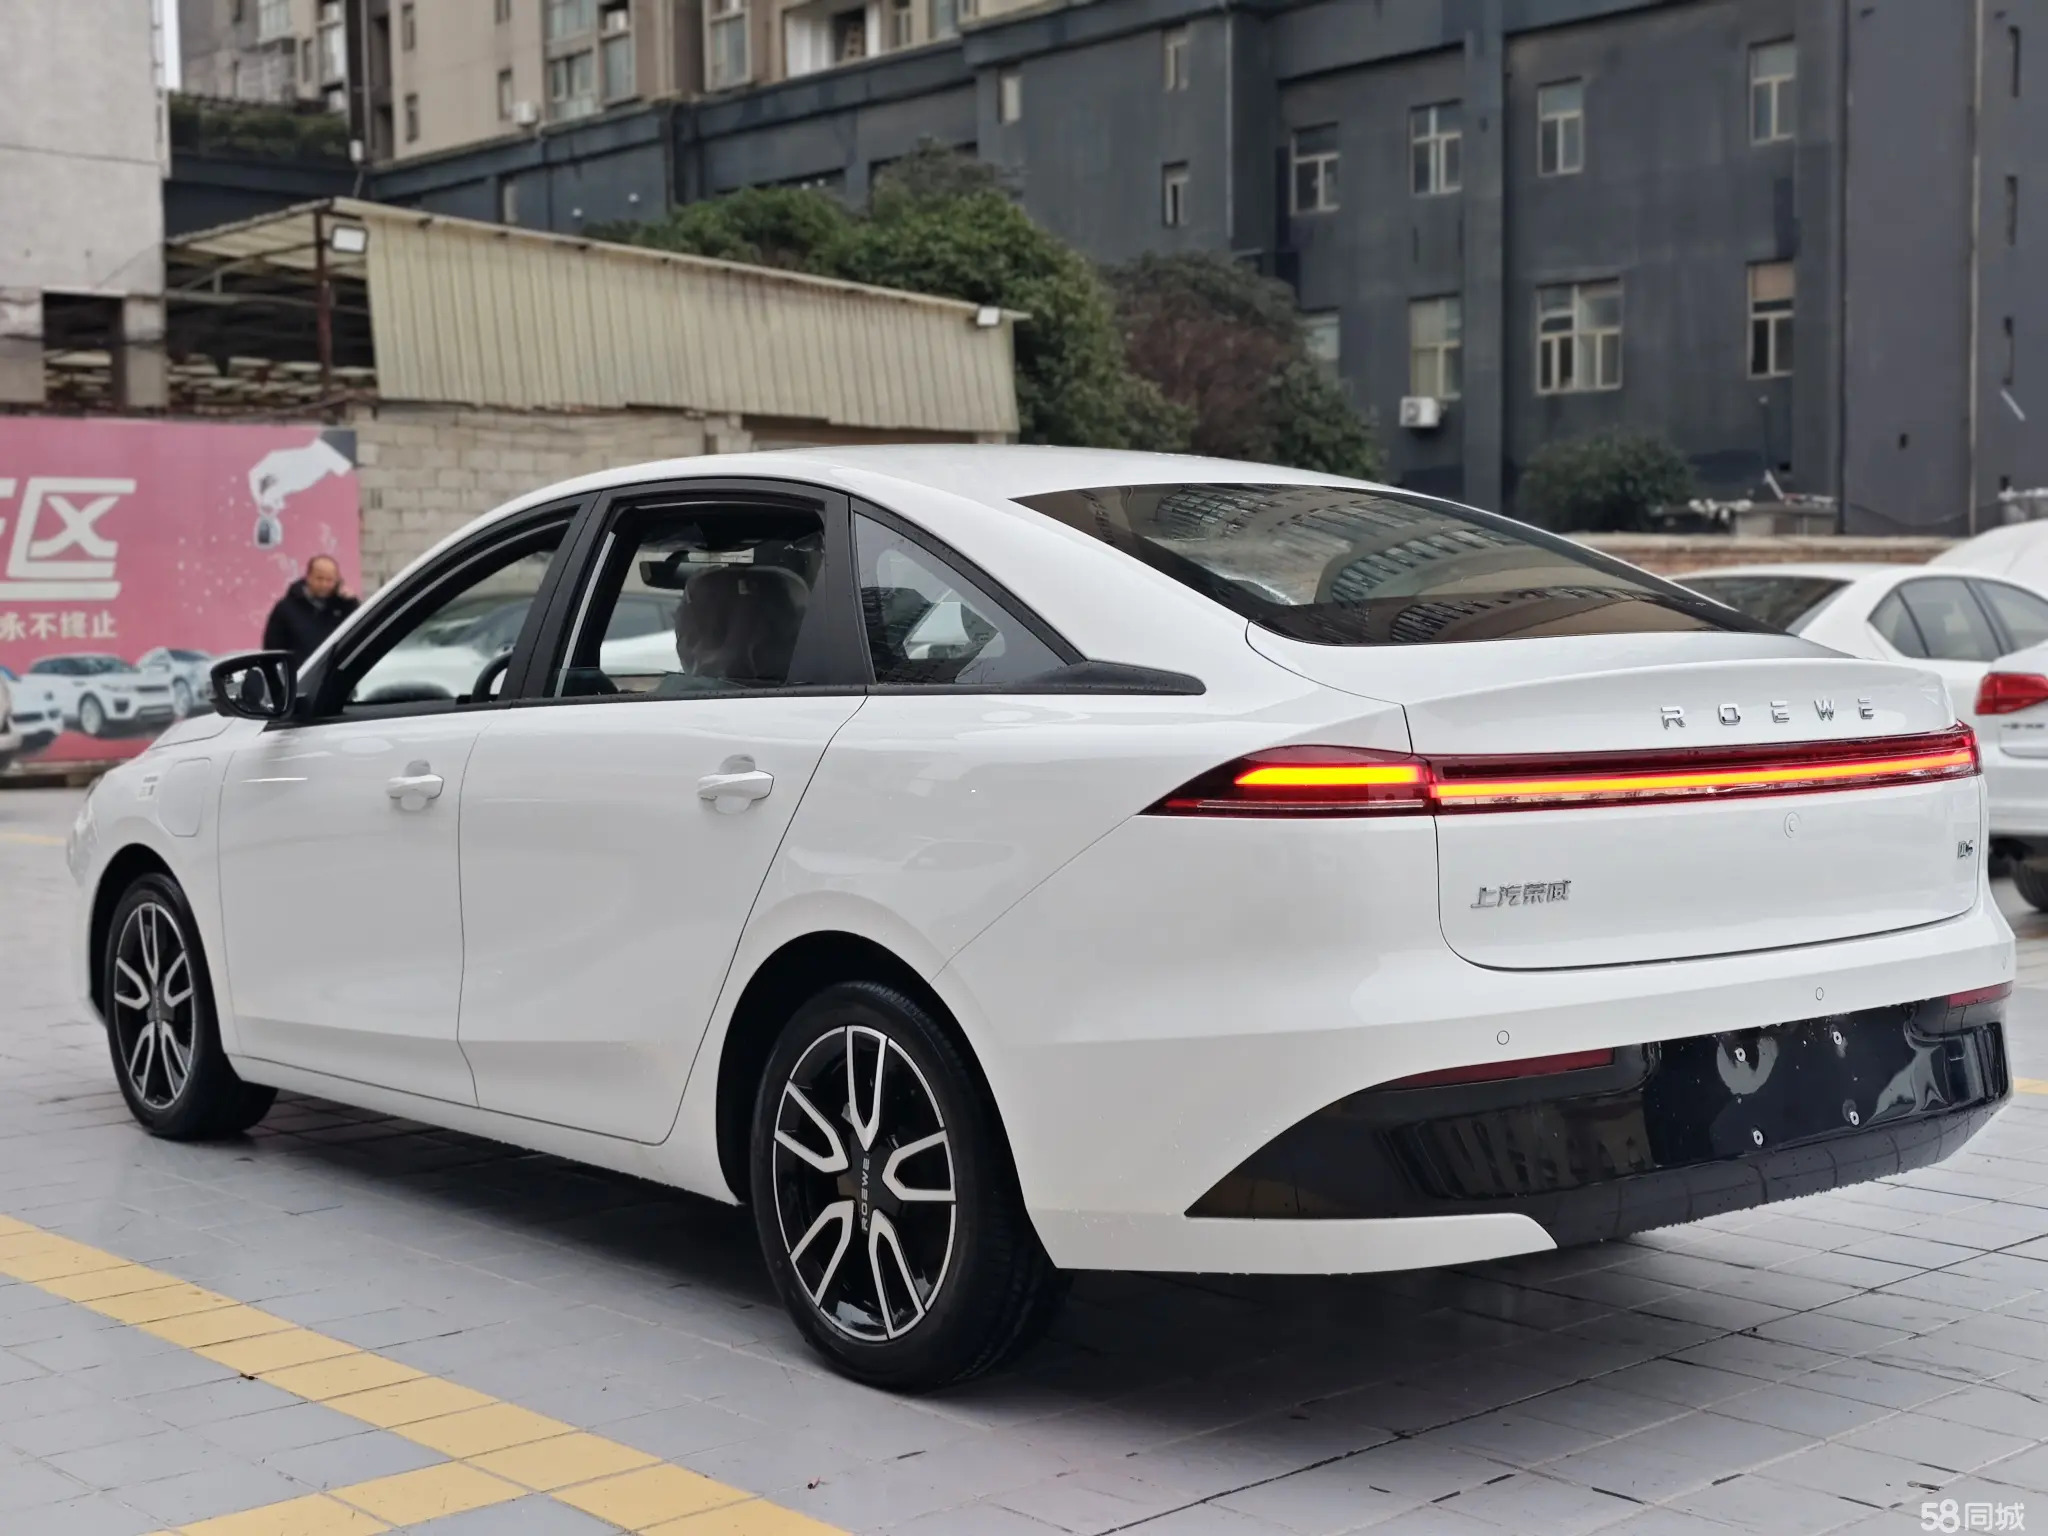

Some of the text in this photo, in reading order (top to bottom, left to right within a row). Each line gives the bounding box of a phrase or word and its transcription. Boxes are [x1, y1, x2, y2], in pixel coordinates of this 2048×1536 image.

[0, 477, 137, 579] 区
[1661, 697, 1875, 730] ROEWE
[1470, 879, 1572, 909] 上汽荣威
[861, 1157, 870, 1232] ROEWE
